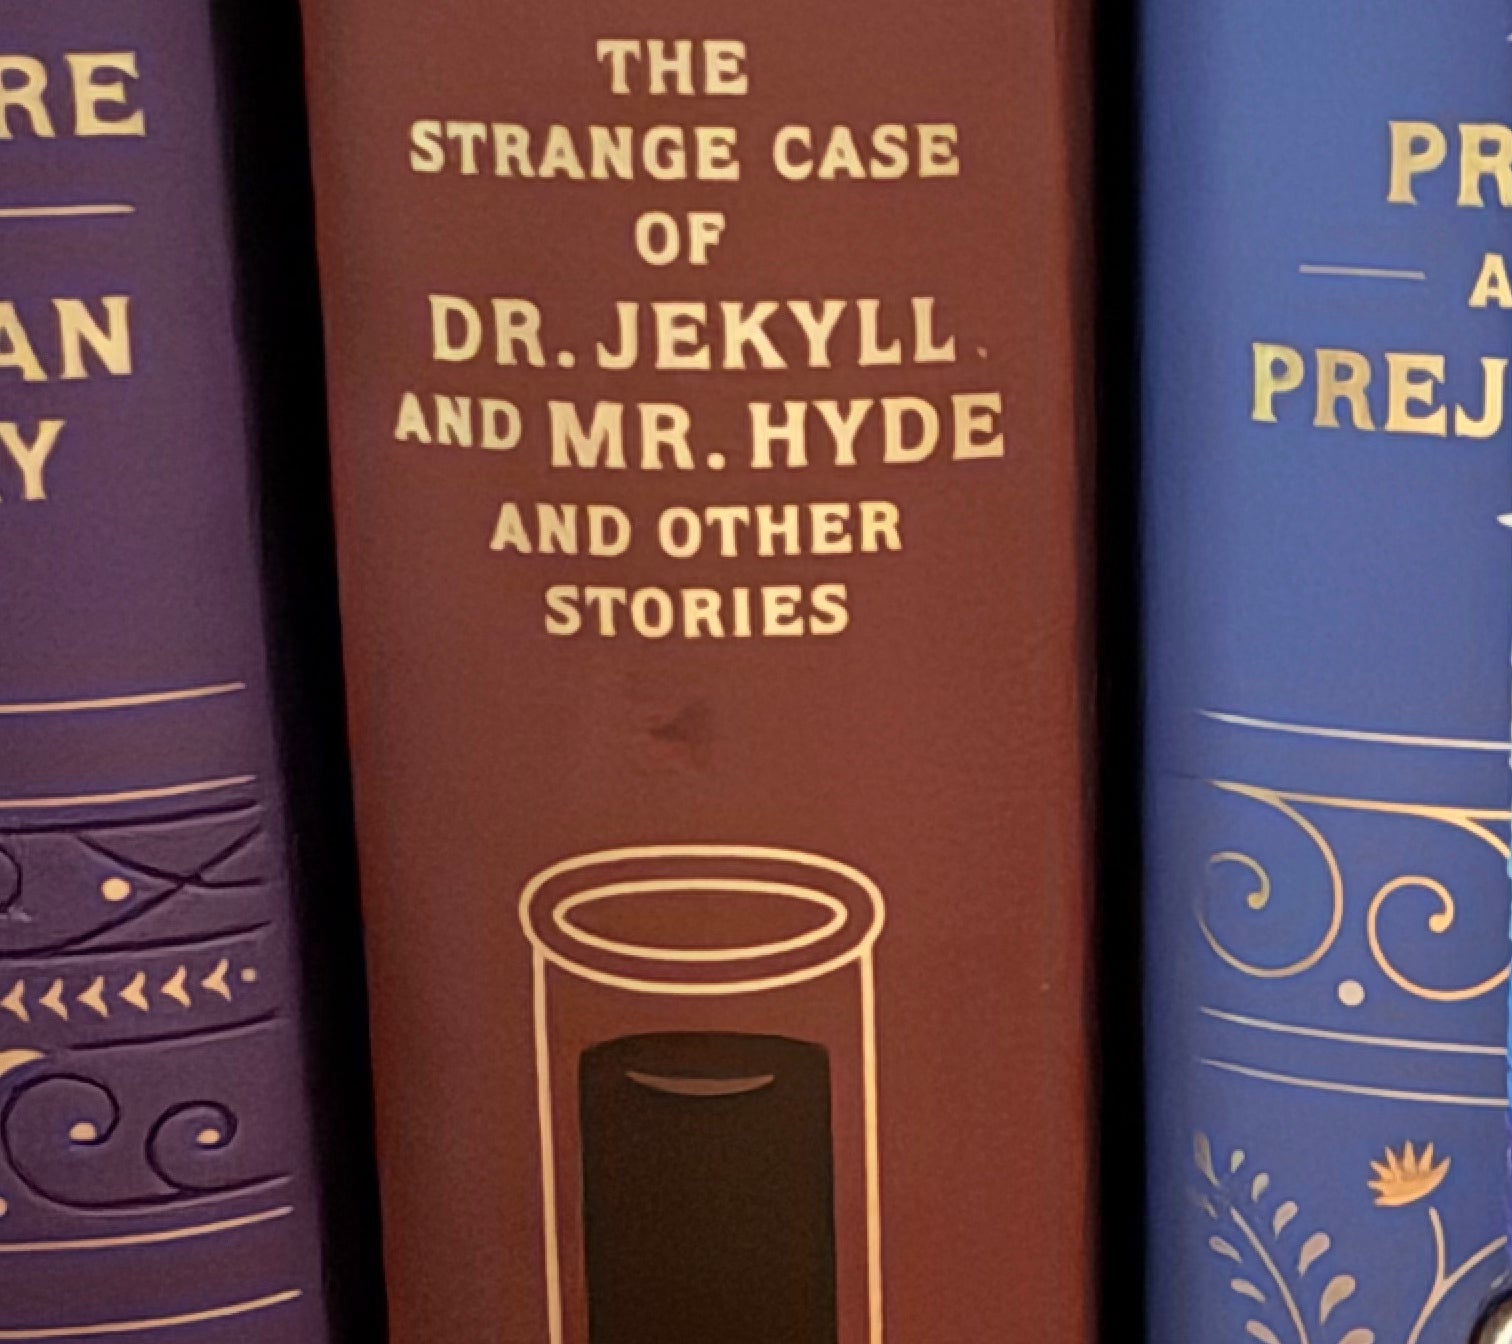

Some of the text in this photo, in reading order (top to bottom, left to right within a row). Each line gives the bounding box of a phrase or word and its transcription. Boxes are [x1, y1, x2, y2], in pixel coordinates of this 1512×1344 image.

[596, 39, 748, 95] THE
[410, 120, 960, 181] STRANGE CASE
[634, 211, 726, 266] OF
[428, 293, 956, 370] DR. JEKYLL
[394, 391, 1005, 471] AND MR. HYDE
[489, 499, 903, 559] AND OTHER
[544, 583, 850, 639] STORIES
